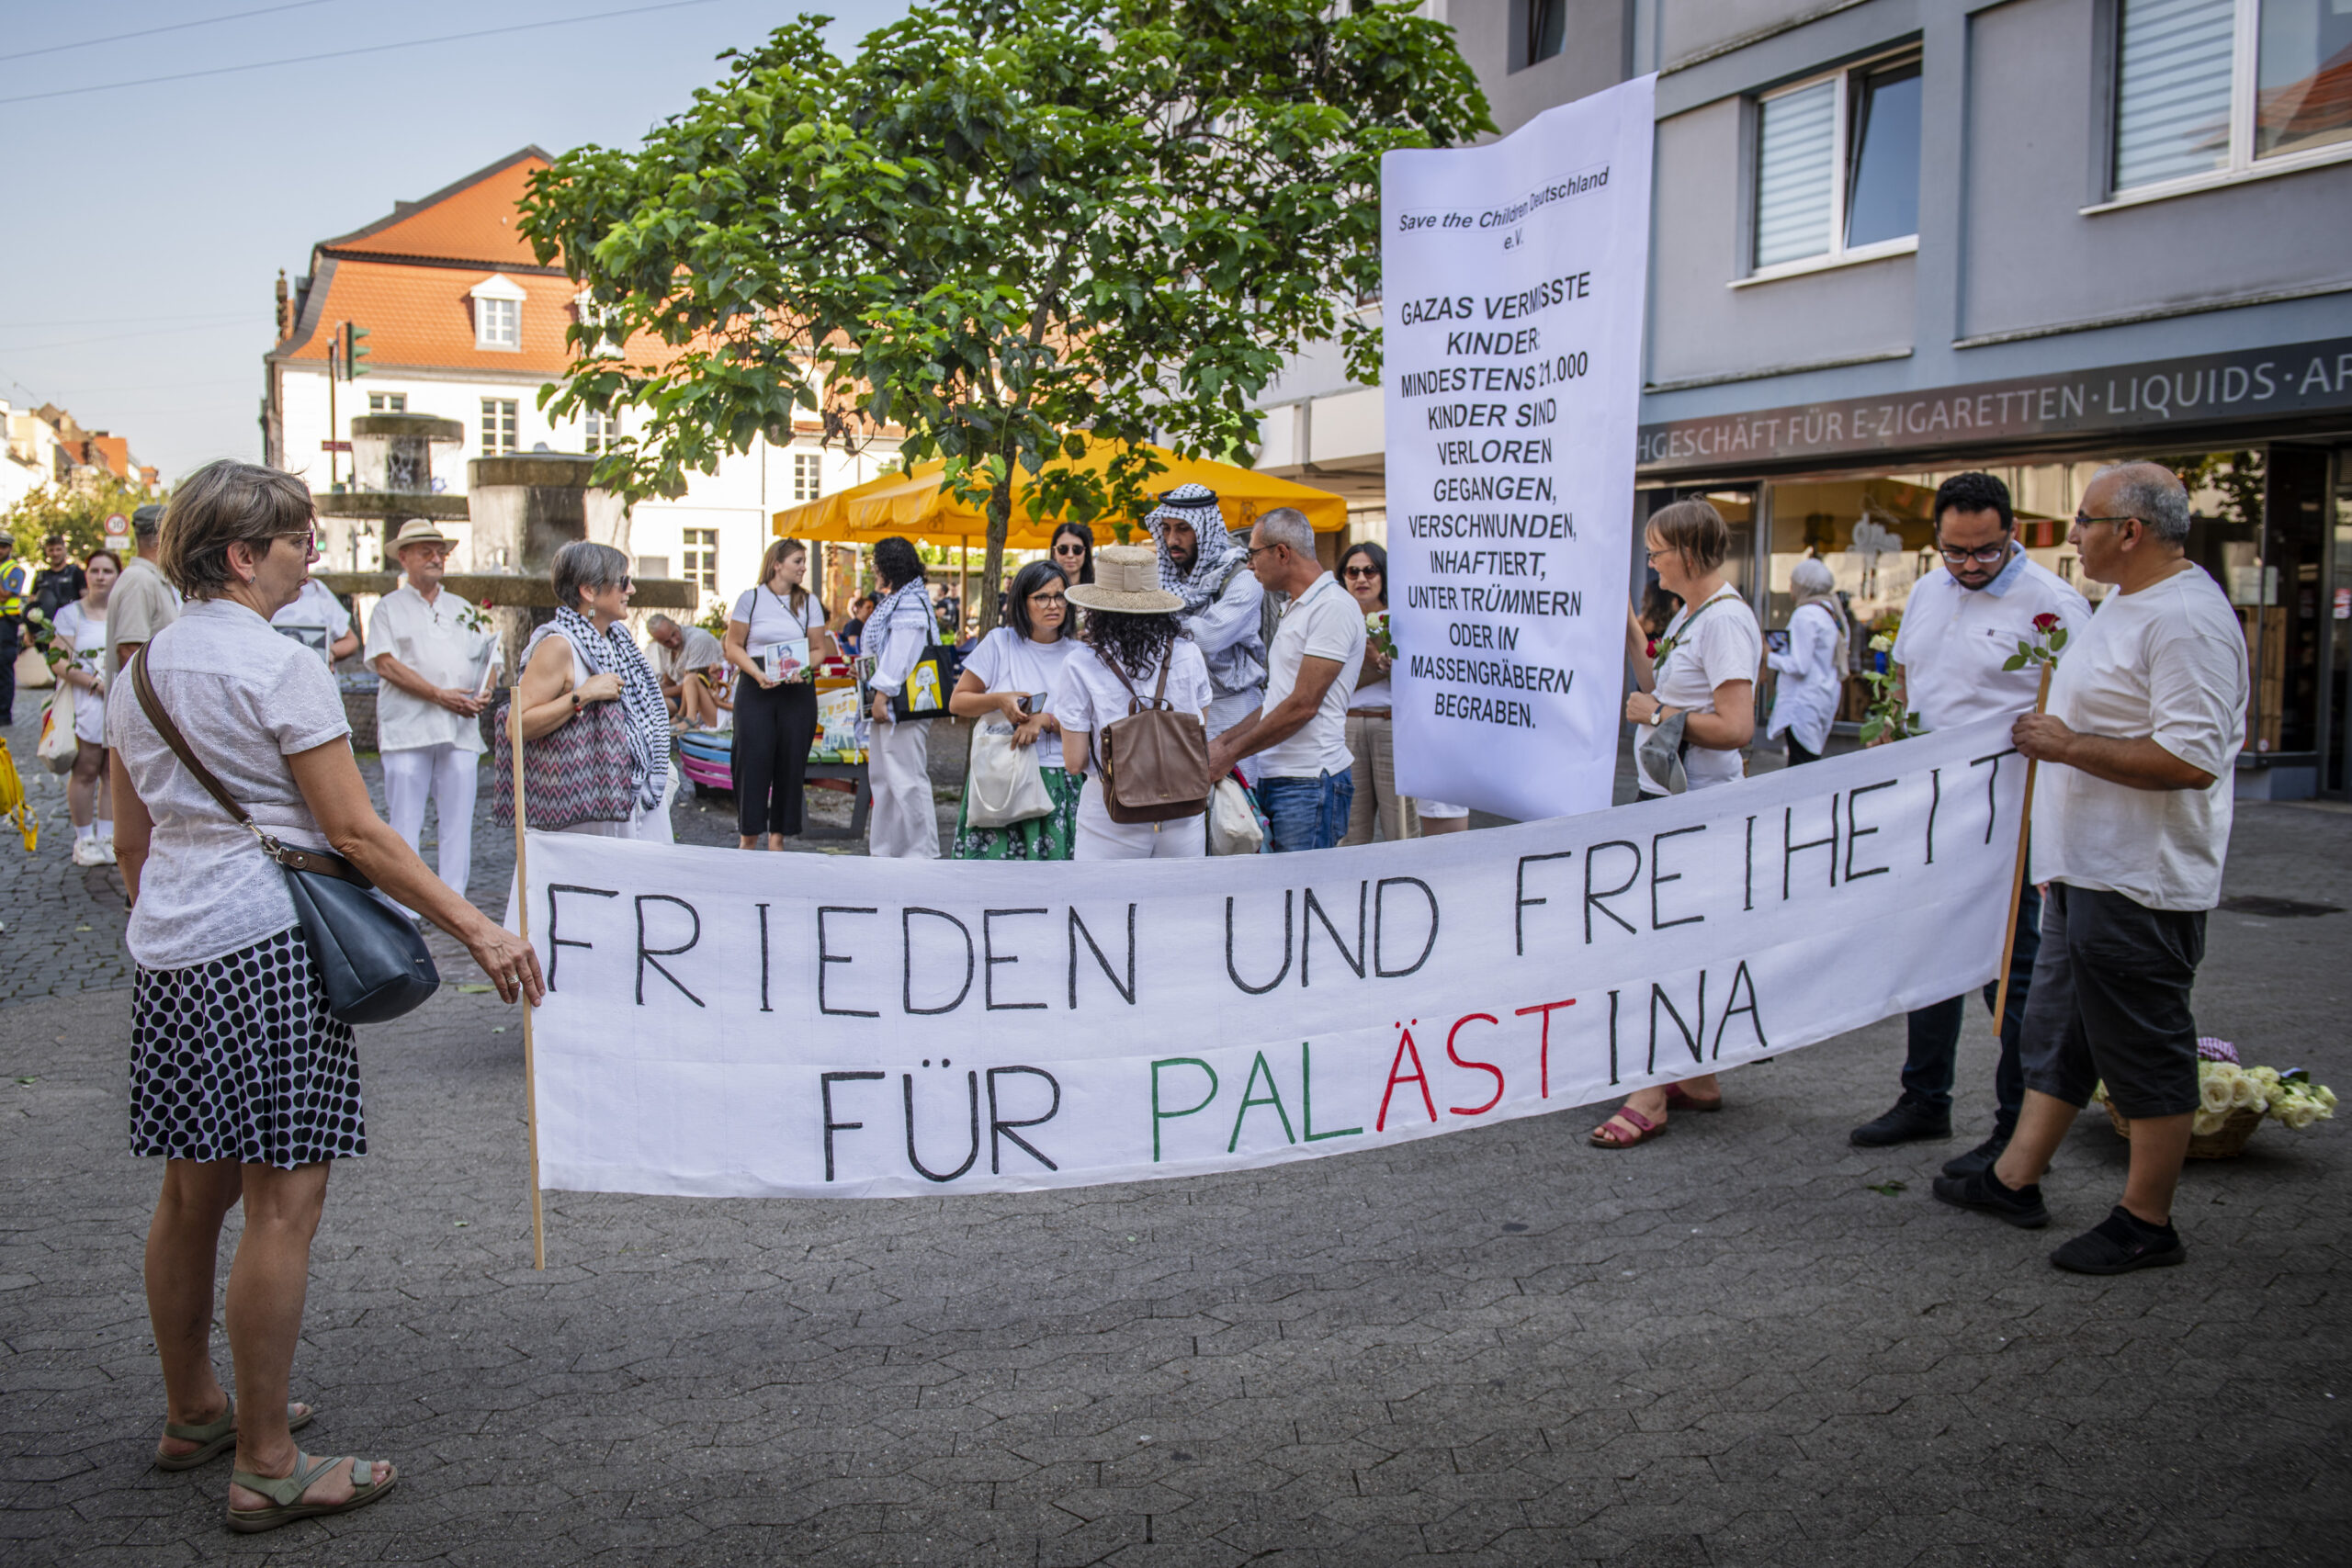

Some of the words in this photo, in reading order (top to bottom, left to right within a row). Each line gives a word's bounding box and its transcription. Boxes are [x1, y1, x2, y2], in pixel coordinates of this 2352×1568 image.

[1399, 214, 1436, 231] Save
[1442, 213, 1473, 229] the
[1479, 201, 1528, 228] Children
[1530, 165, 1610, 211] Deutschland
[1504, 227, 1523, 250] e.V.
[1402, 296, 1474, 325] GAZAS
[1484, 271, 1590, 320] VERMISSTE
[1447, 327, 1540, 355] KINDER:
[1401, 366, 1535, 399] MINDESTENS
[1539, 351, 1588, 387] 21.000
[1429, 404, 1507, 431] KINDER
[1515, 398, 1556, 427] SIND
[1788, 408, 1844, 446] FÜR
[1852, 384, 2085, 439] E-ZIGARETTEN
[2107, 363, 2276, 419] LIQUIDS
[1438, 438, 1552, 466] VERLOREN
[1434, 476, 1556, 505] GEGANGEN,
[1408, 513, 1577, 542] VERSCHWUNDEN,
[1430, 550, 1546, 581] INHAFTIERT,
[1408, 586, 1458, 611] UNTER
[1461, 584, 1582, 616] TRÜMMERN
[1450, 623, 1492, 649] ODER
[1498, 626, 1519, 651] IN
[1411, 655, 1574, 694] MASSENGRÄBERN
[1435, 693, 1536, 729] BEGRABEN.
[547, 883, 1136, 1018] FRIEDEN
[1226, 876, 1440, 995] UND
[1516, 747, 2018, 955] FREIHEIT
[820, 1058, 1059, 1182] FÜR
[1151, 961, 1767, 1163] PALÄSTINA
